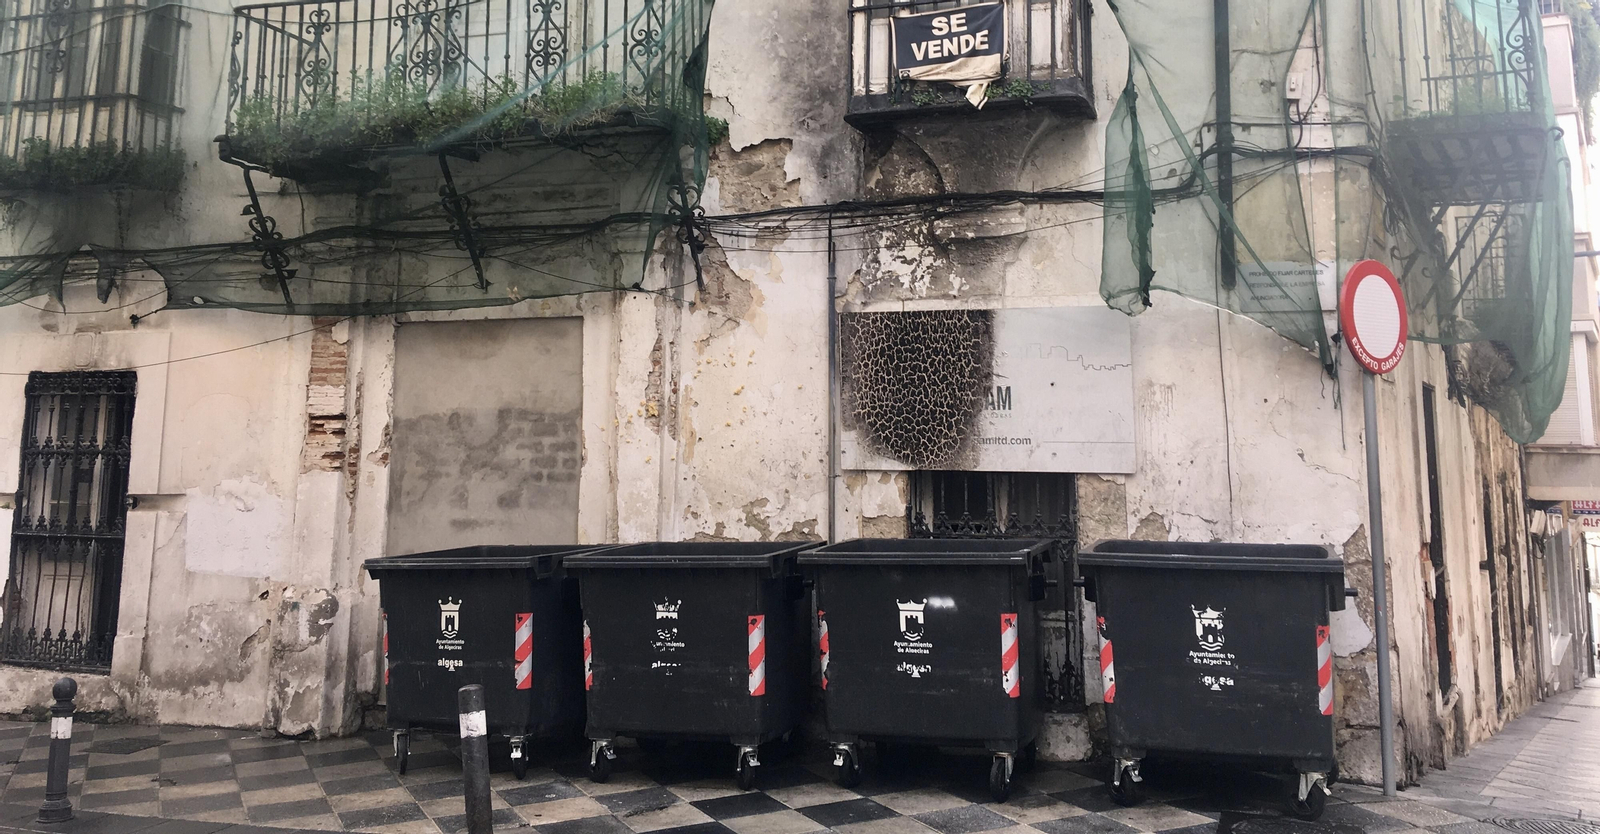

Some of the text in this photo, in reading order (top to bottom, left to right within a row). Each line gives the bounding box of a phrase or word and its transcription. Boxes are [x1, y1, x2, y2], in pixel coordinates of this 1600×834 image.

[931, 12, 968, 36] SE
[910, 29, 989, 61] VENDE
[1351, 337, 1405, 371] EXCEPTO GARAJES
[435, 638, 465, 647] Ayuntamiento
[437, 657, 464, 669] algesa
